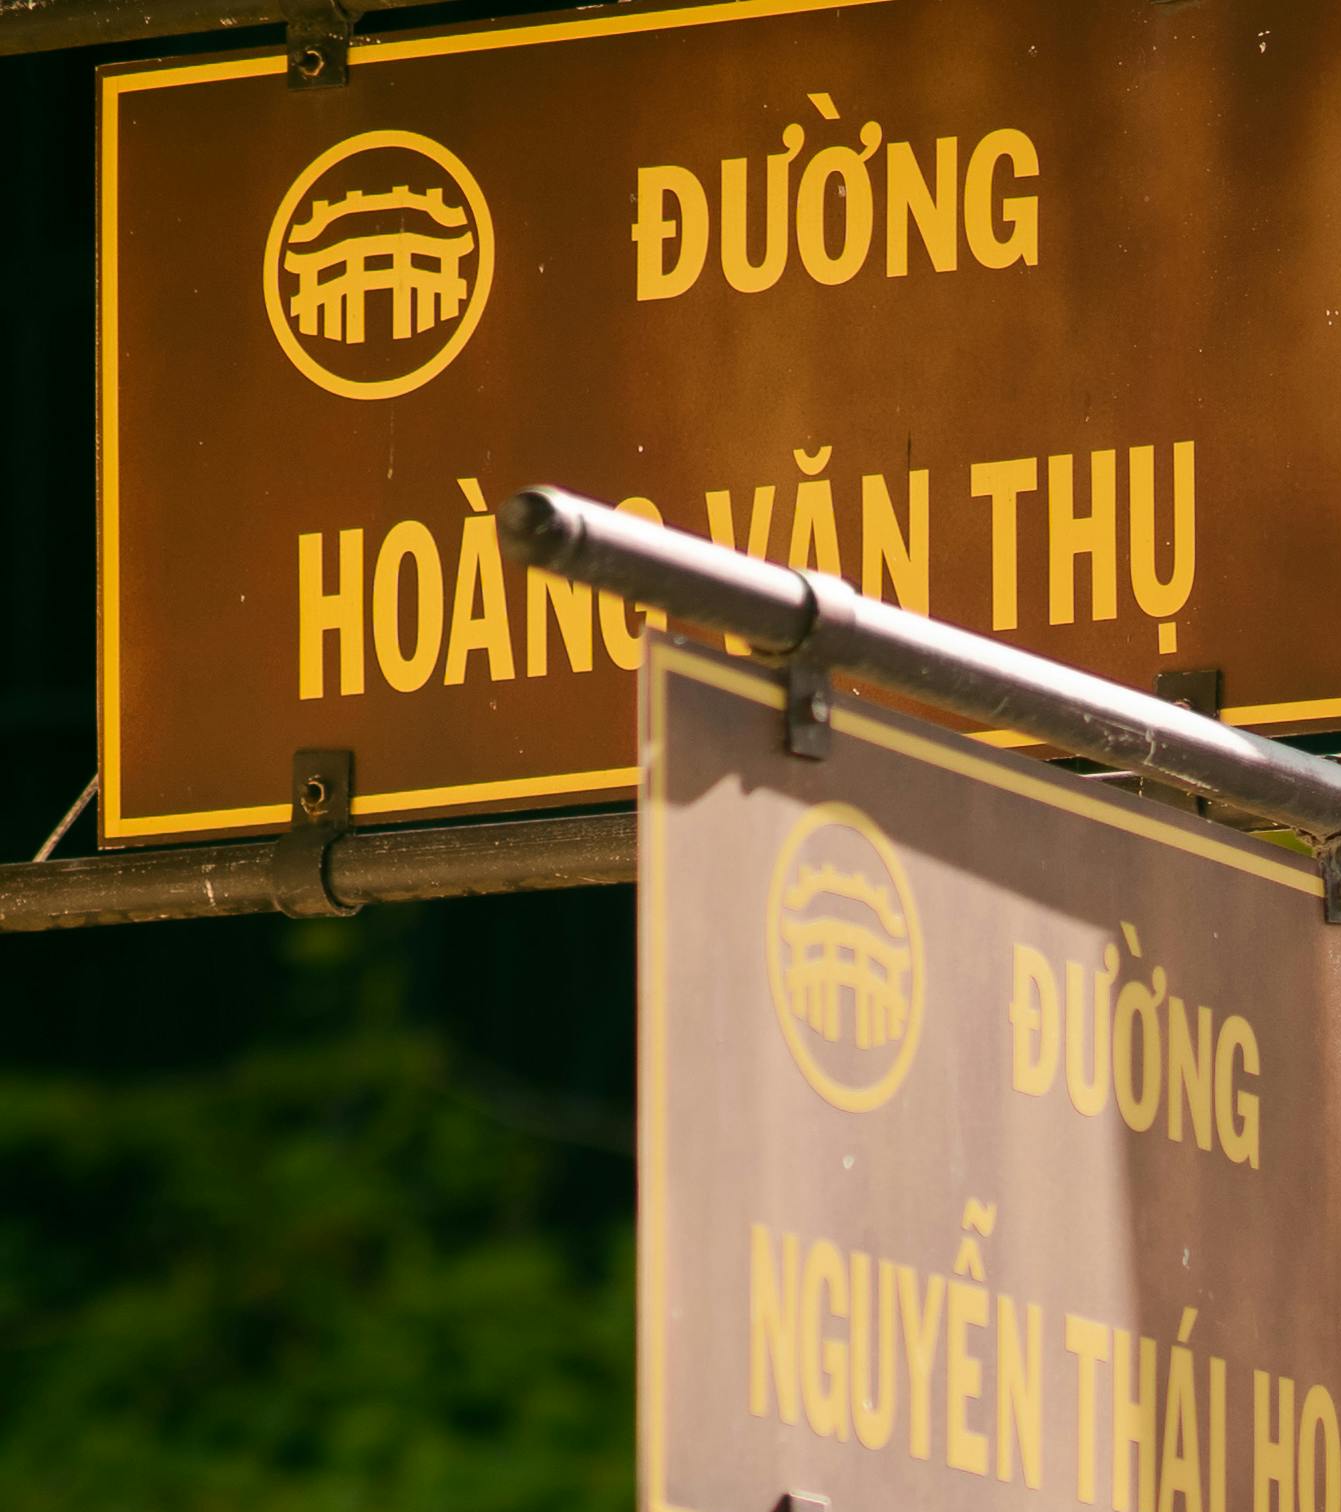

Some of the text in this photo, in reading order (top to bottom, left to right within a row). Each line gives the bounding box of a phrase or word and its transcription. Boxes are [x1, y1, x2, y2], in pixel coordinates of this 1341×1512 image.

[631, 93, 1041, 303] ĐƯỜNG
[970, 440, 1197, 655] THỤ
[1009, 921, 1262, 1169] ĐƯỜNG
[750, 1198, 1043, 1491] NGUYỄN
